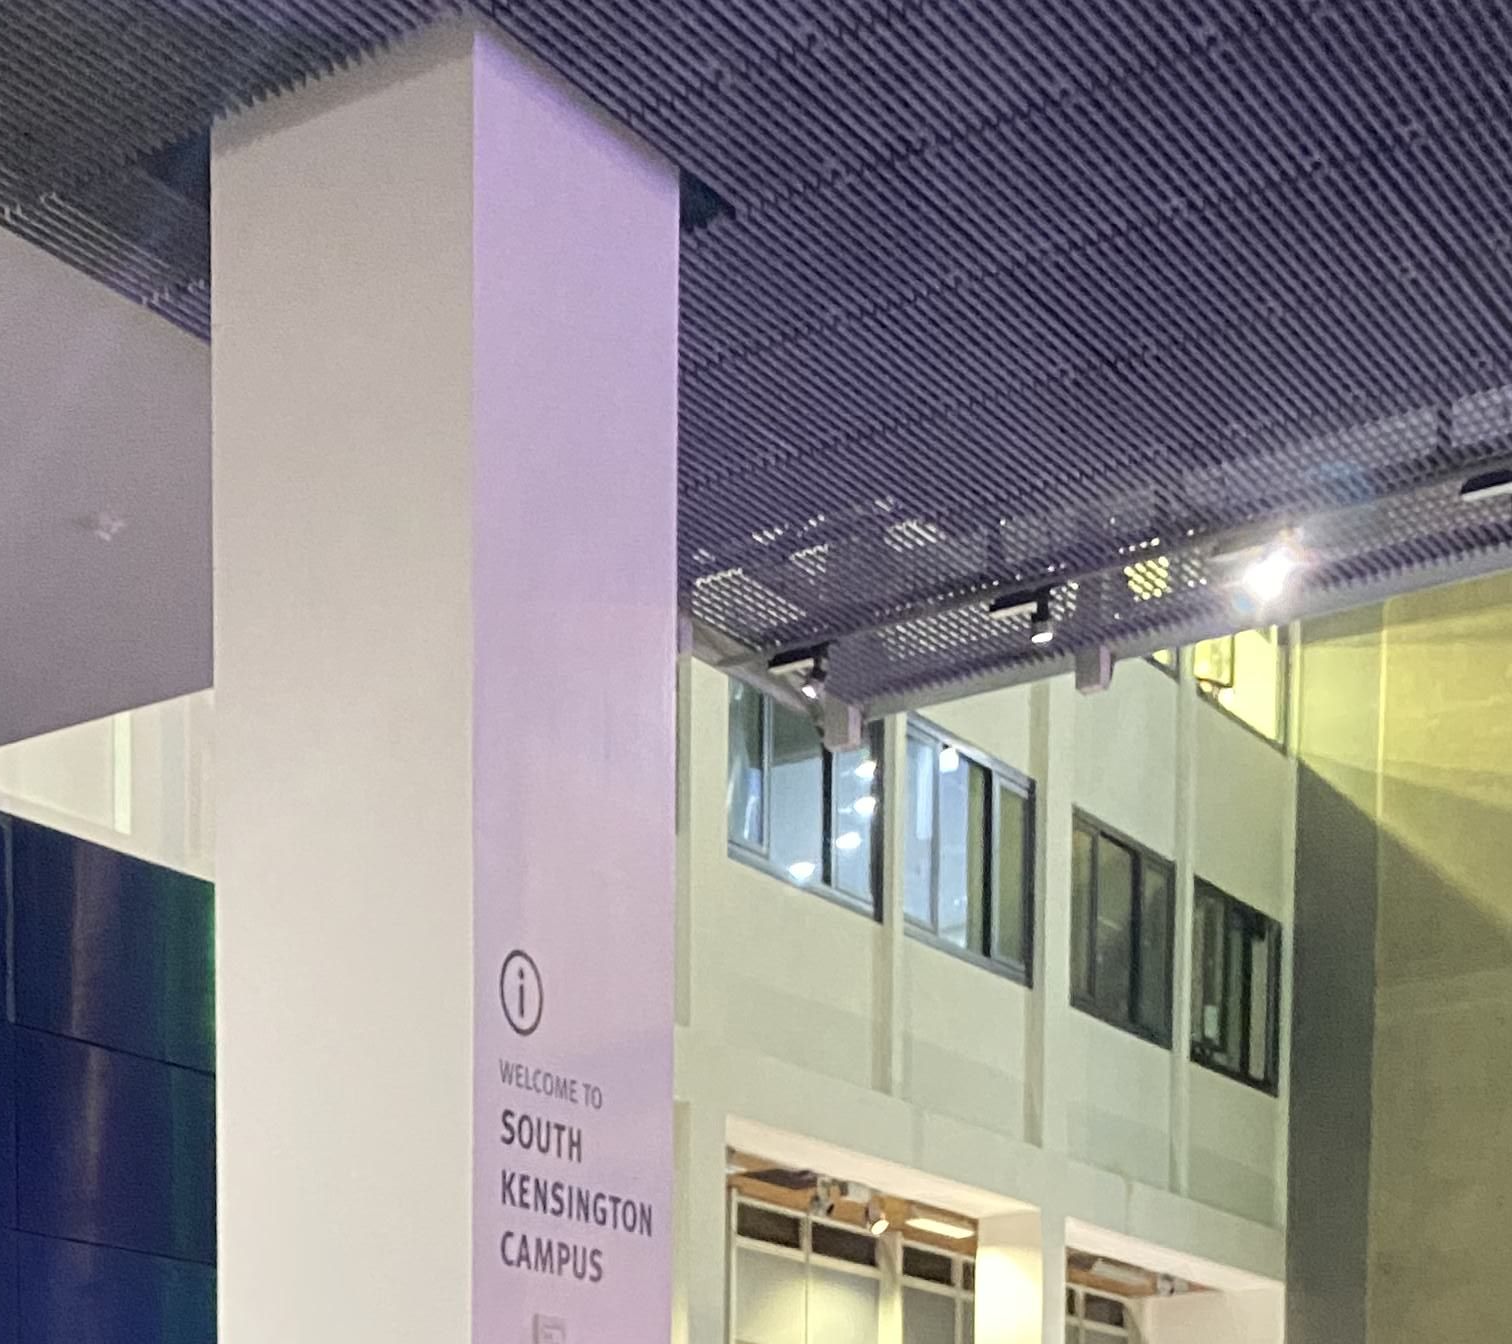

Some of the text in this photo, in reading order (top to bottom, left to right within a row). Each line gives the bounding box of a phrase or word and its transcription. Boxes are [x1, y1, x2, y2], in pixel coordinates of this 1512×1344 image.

[498, 1059, 603, 1110] WELCOME TO
[500, 1109, 583, 1163] SOUTH
[500, 1169, 653, 1237] KENSINGTON
[500, 1230, 604, 1283] CAMPUS
